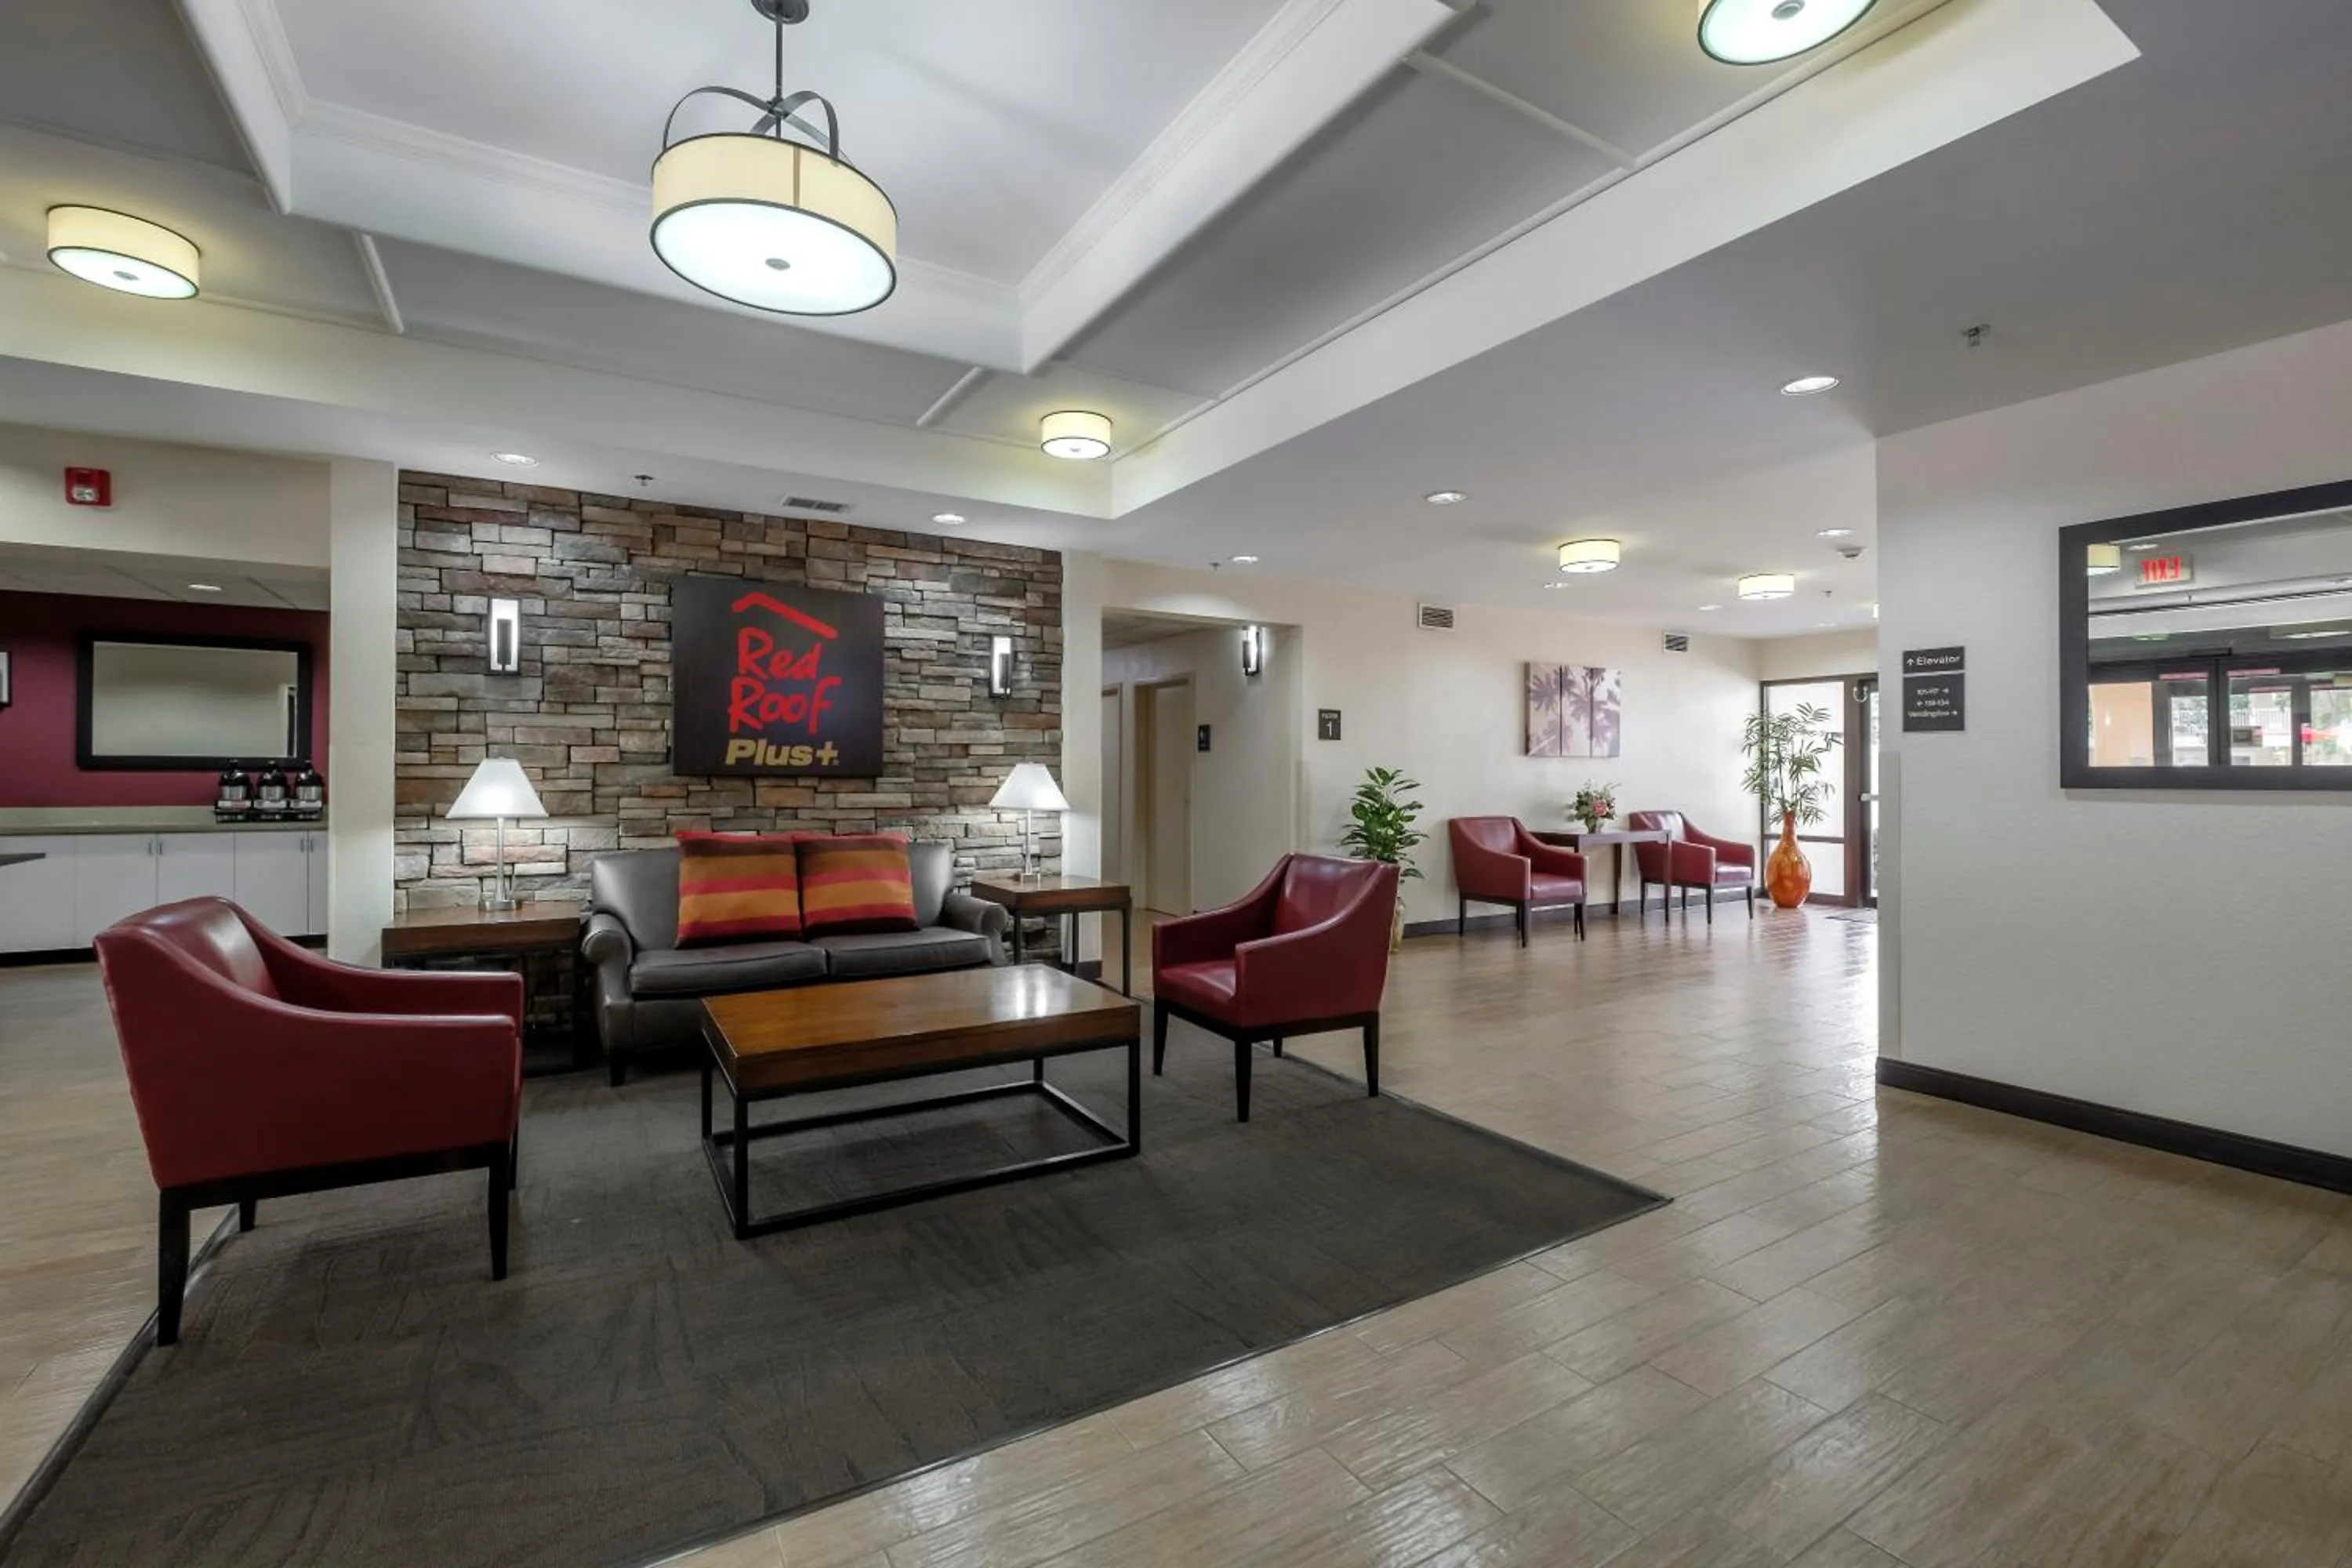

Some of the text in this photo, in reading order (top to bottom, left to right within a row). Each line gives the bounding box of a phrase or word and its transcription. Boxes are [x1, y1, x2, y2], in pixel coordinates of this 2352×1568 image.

[738, 626, 822, 680] Red
[728, 677, 842, 735] Roof
[1327, 720, 1332, 737] 1
[725, 739, 838, 766] Plus+
